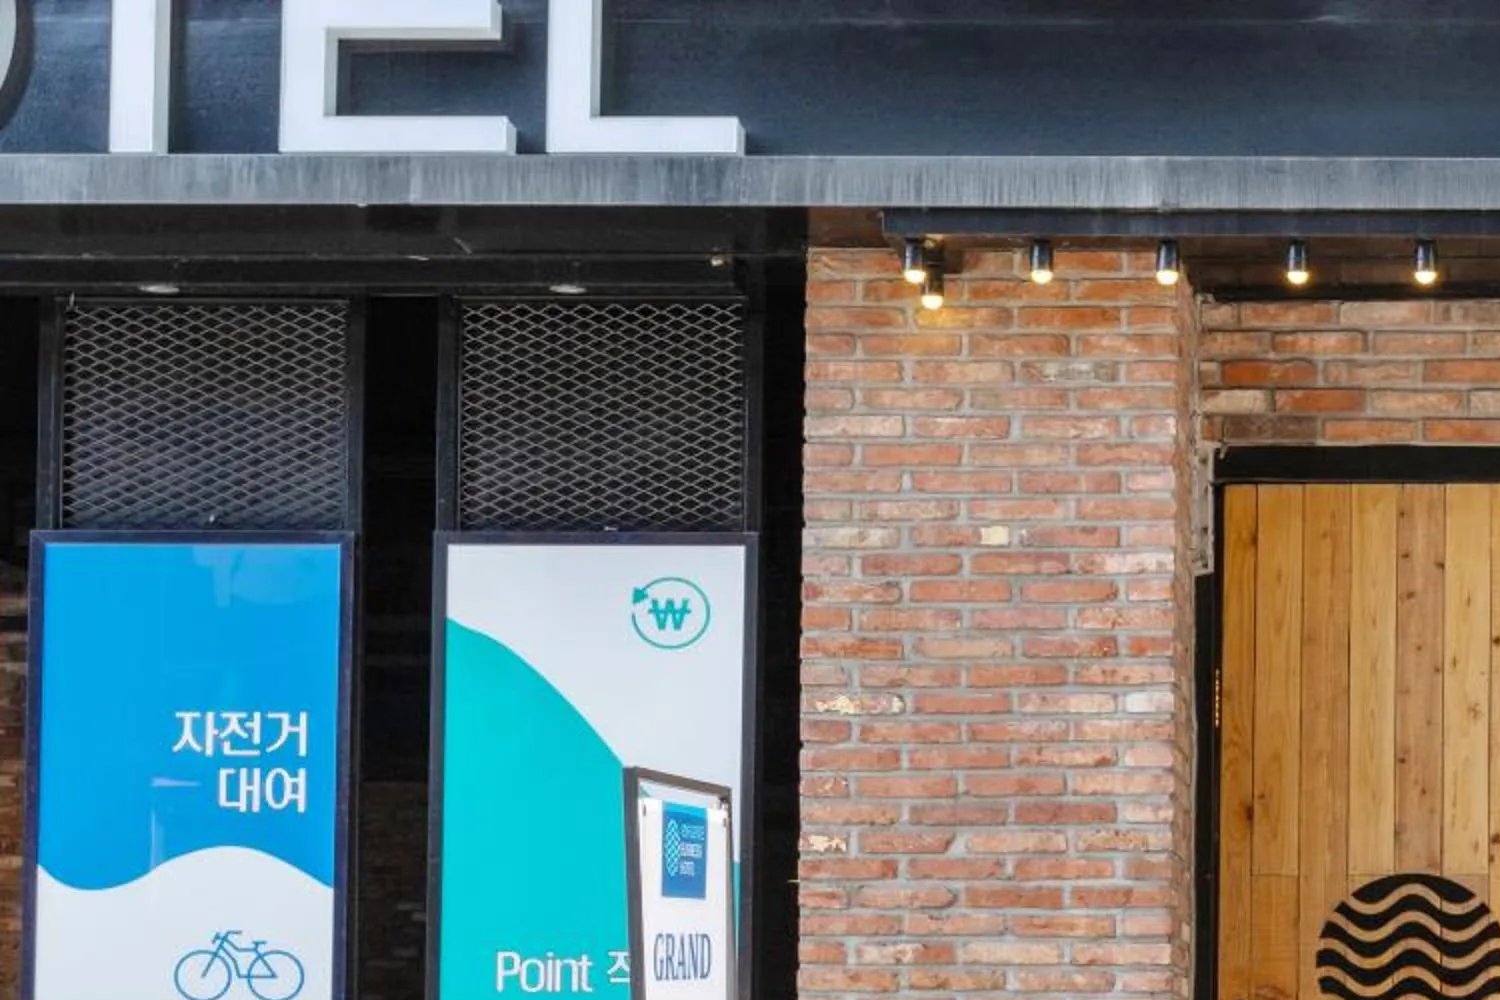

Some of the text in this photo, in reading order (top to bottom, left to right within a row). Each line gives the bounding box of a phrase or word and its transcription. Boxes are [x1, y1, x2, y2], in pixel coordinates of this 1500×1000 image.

[172, 711, 307, 757] 자전거
[218, 767, 307, 813] 대여
[495, 951, 593, 992] Point
[653, 932, 711, 980] GRAND
